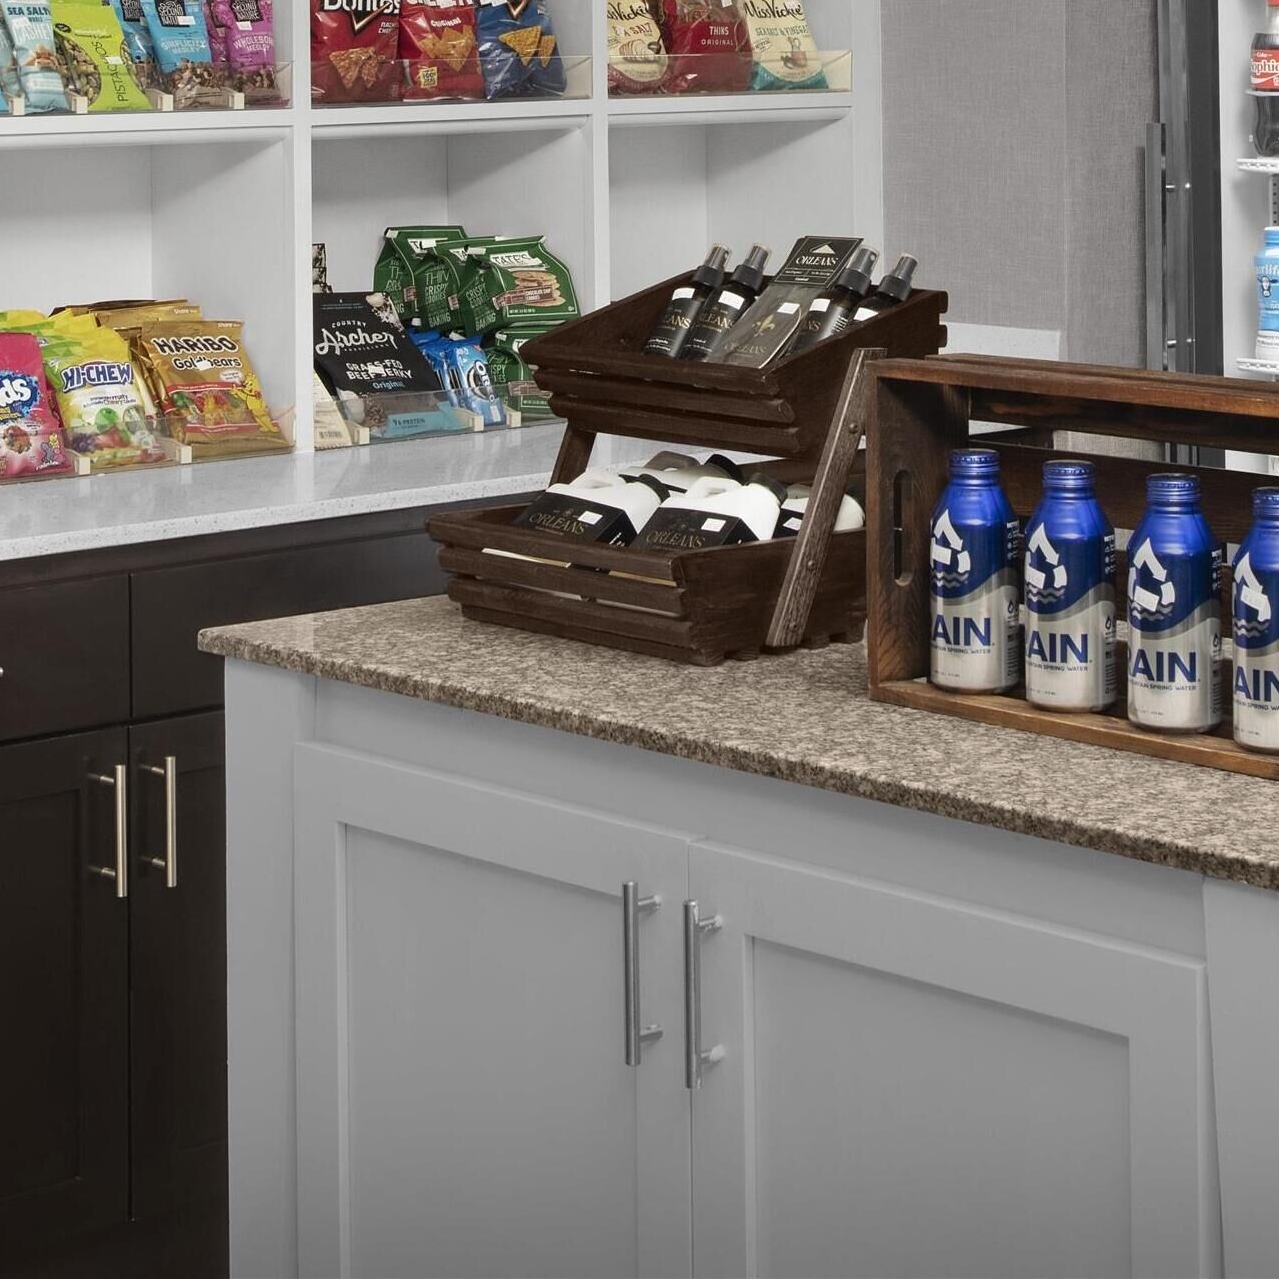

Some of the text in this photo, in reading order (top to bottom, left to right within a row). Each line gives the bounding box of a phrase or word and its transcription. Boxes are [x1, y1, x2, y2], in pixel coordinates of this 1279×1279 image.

[7, 7, 24, 16] SEA
[709, 26, 729, 35] THINS
[234, 36, 272, 50] WHOLESO
[701, 38, 734, 46] ORIGINAL
[492, 253, 532, 267] TATE'S
[332, 320, 367, 329] COUNTRY
[151, 335, 239, 355] HARIBO
[315, 327, 399, 355] Archer
[62, 363, 133, 393] HI-CHEW
[933, 613, 991, 647] AIN
[1027, 630, 1089, 663] AIN
[1128, 648, 1197, 683] AIN
